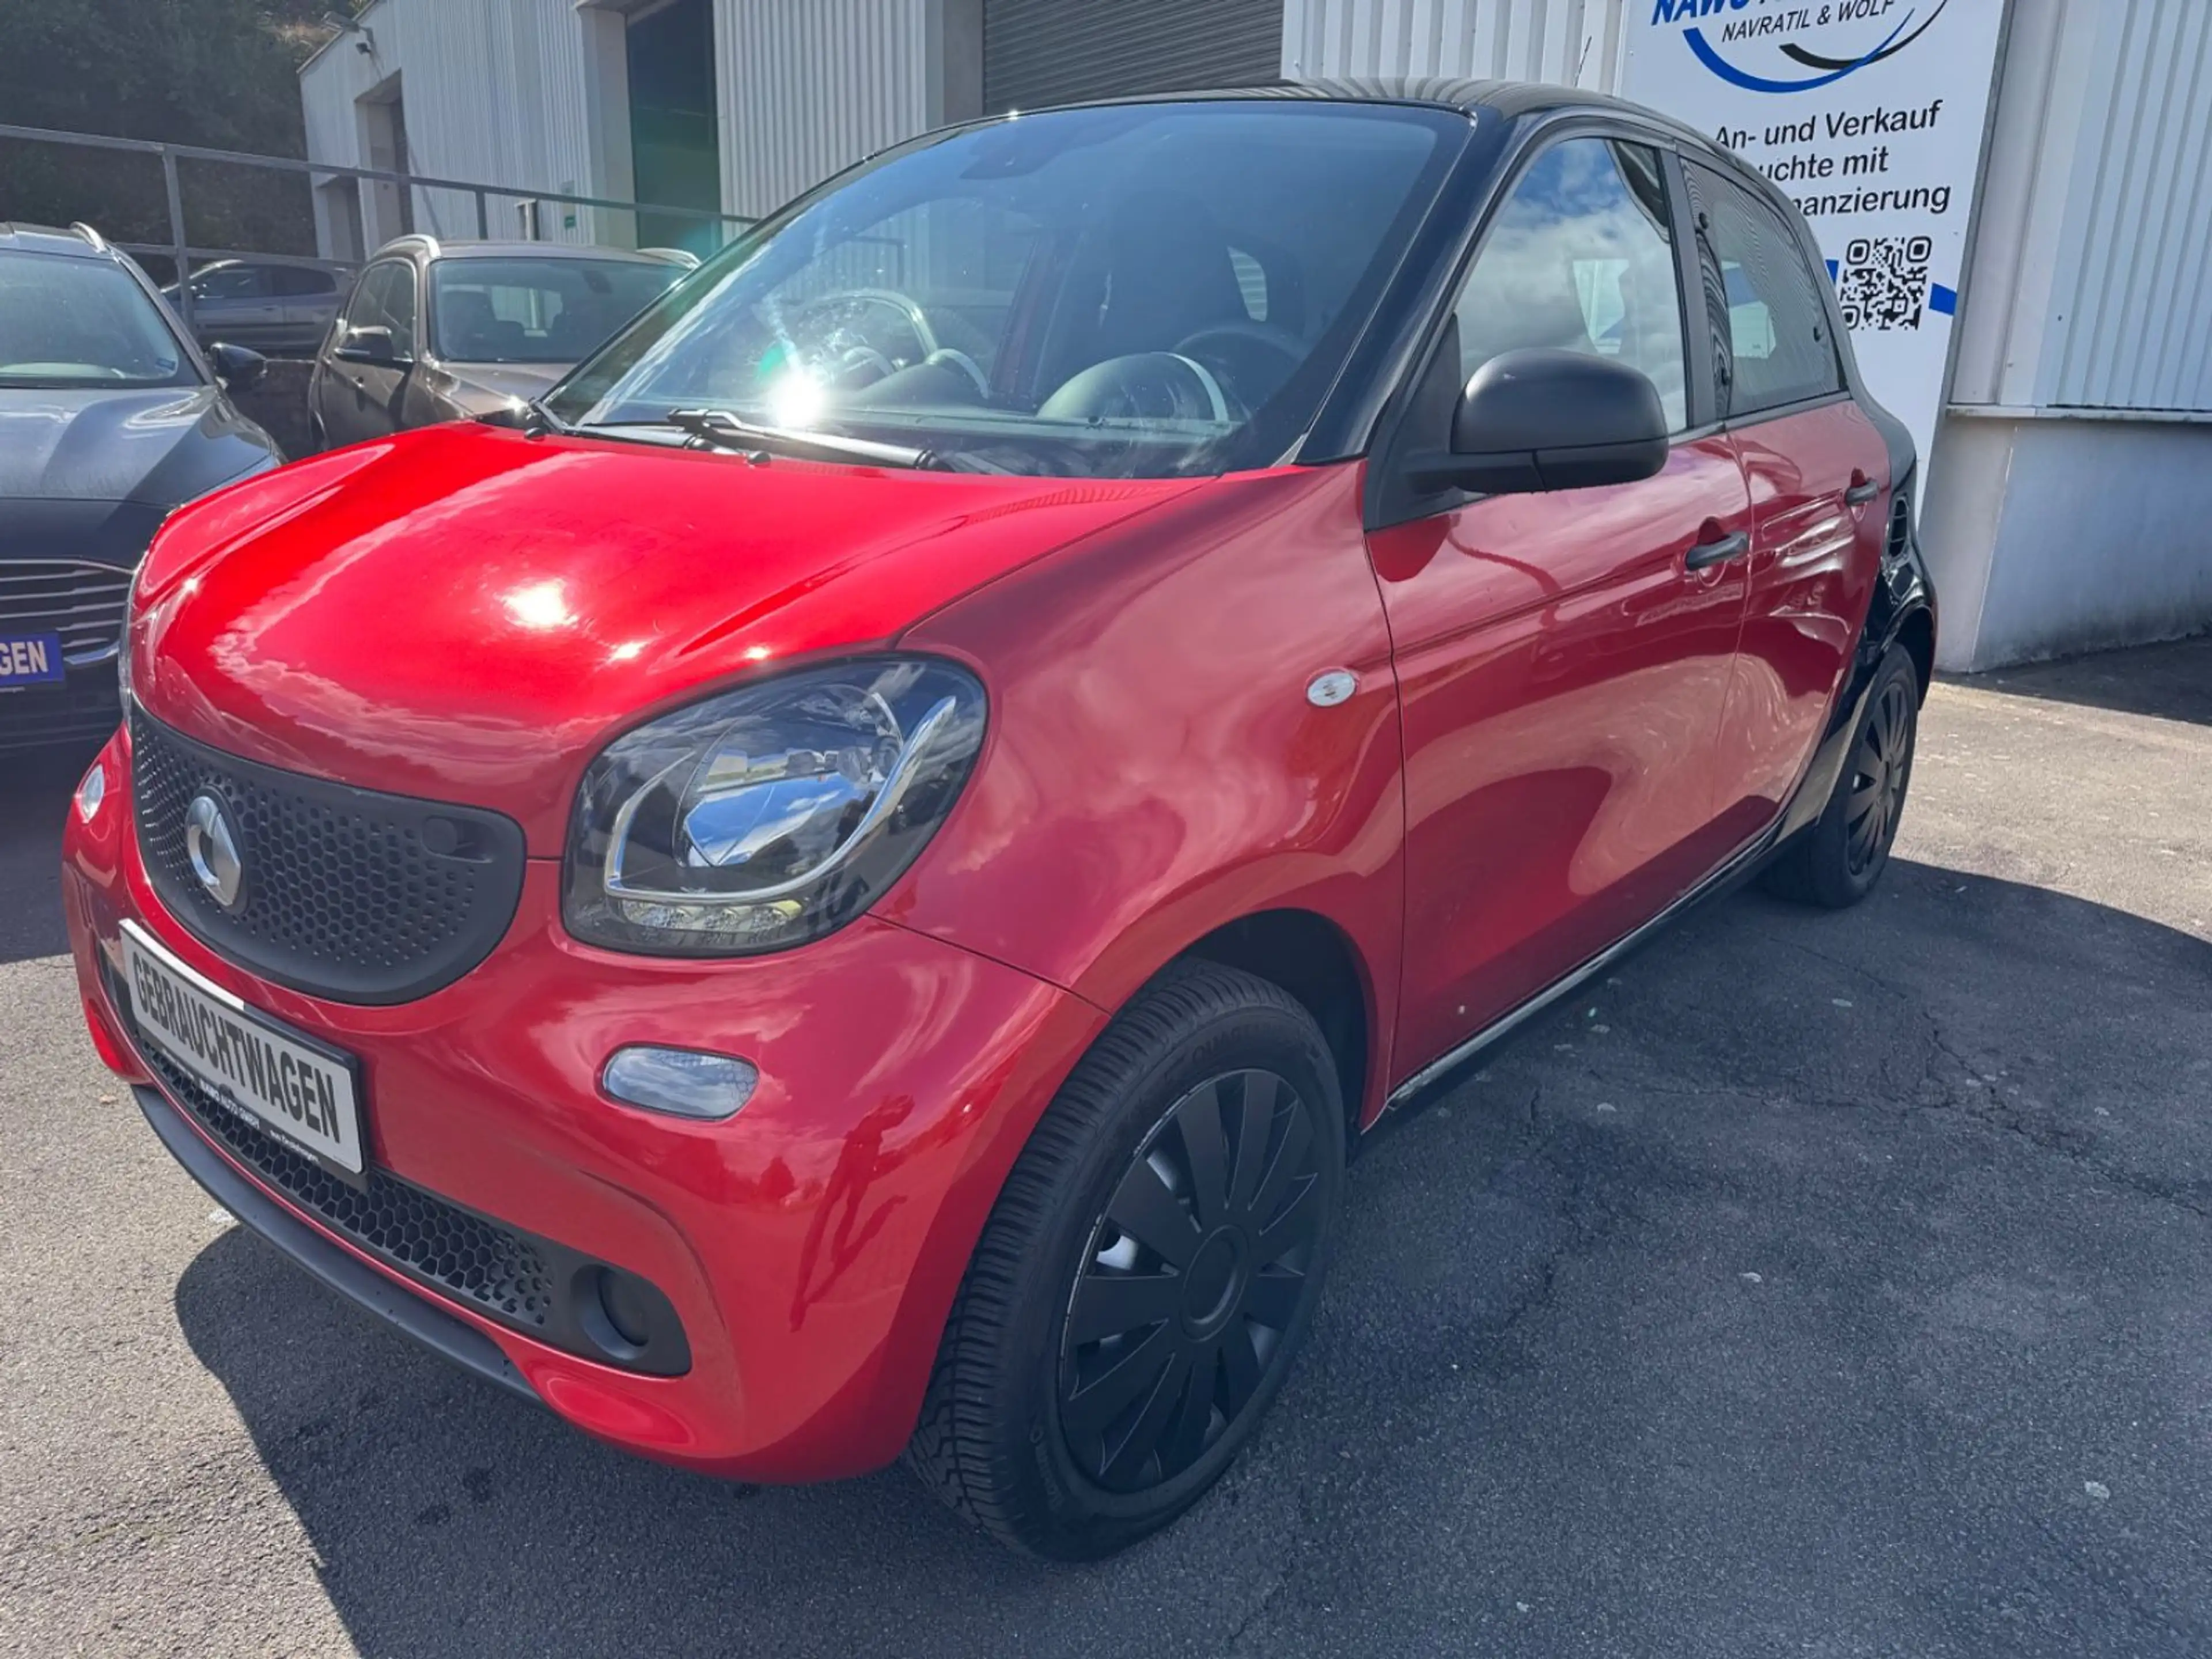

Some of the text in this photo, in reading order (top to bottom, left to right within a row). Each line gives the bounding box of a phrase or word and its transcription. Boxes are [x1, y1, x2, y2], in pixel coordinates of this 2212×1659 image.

[1721, 0, 1894, 43] NAVRATIL & WOLF
[1716, 99, 1944, 150] An- und Verkauf
[1842, 146, 1889, 176] mit
[132, 951, 341, 1144] GEBRAUCHTWAGEN
